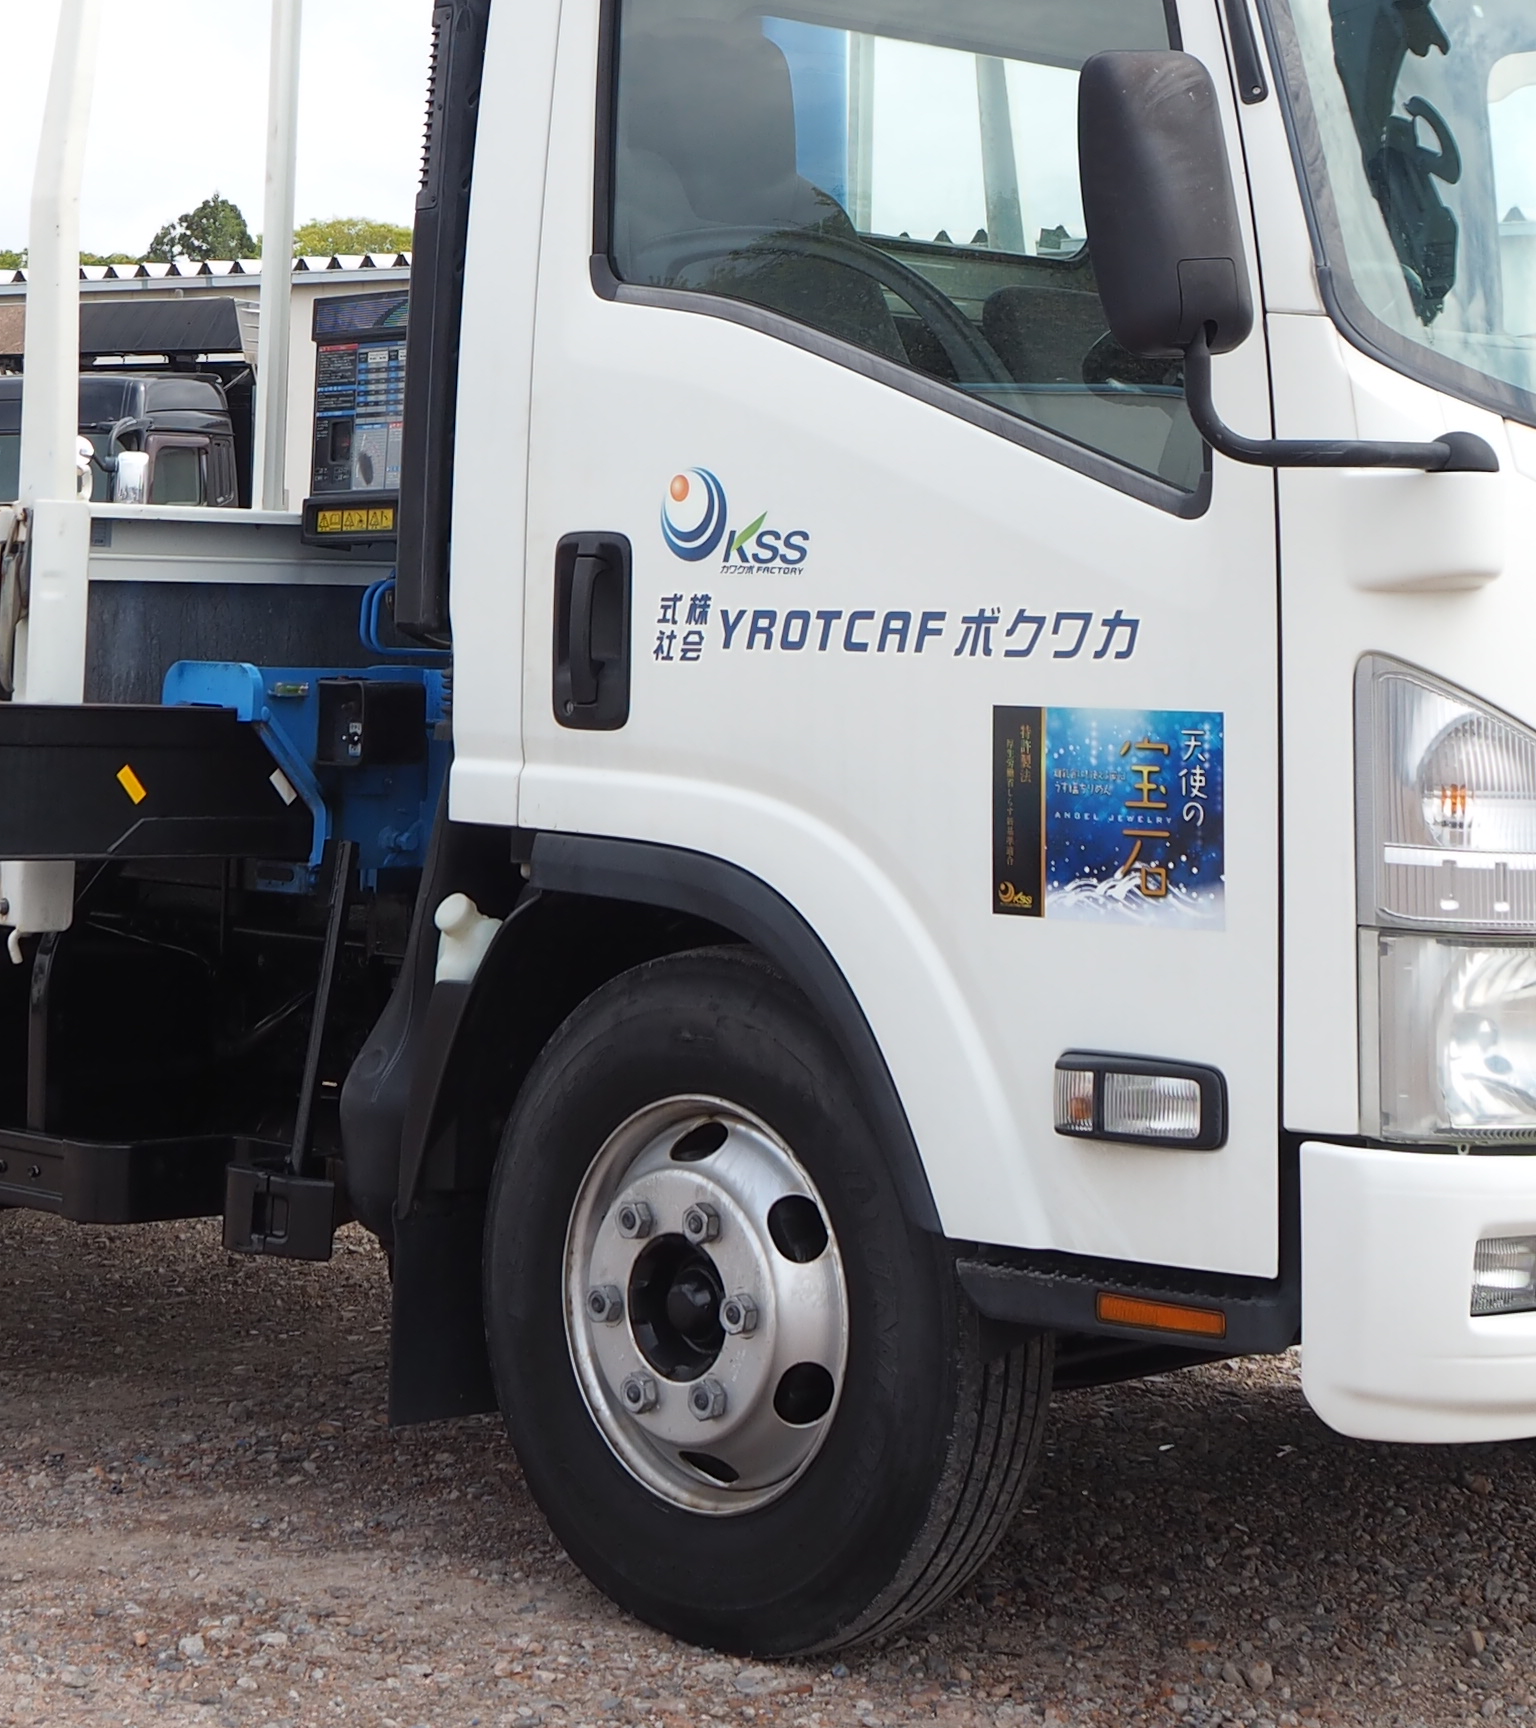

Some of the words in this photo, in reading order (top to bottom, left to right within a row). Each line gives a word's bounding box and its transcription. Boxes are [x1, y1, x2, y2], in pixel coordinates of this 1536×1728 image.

[722, 510, 810, 565] KSS
[719, 564, 755, 575] カワクボ
[755, 566, 804, 576] FACTORY
[719, 607, 946, 653] YROTCAF
[954, 607, 1141, 660] ボクワカ
[1020, 724, 1032, 783] 特許製法
[1178, 729, 1208, 827] 天使の
[1054, 811, 1100, 822] ANGEL
[1107, 814, 1173, 825] JEWELRY
[1120, 737, 1171, 897] 宝石
